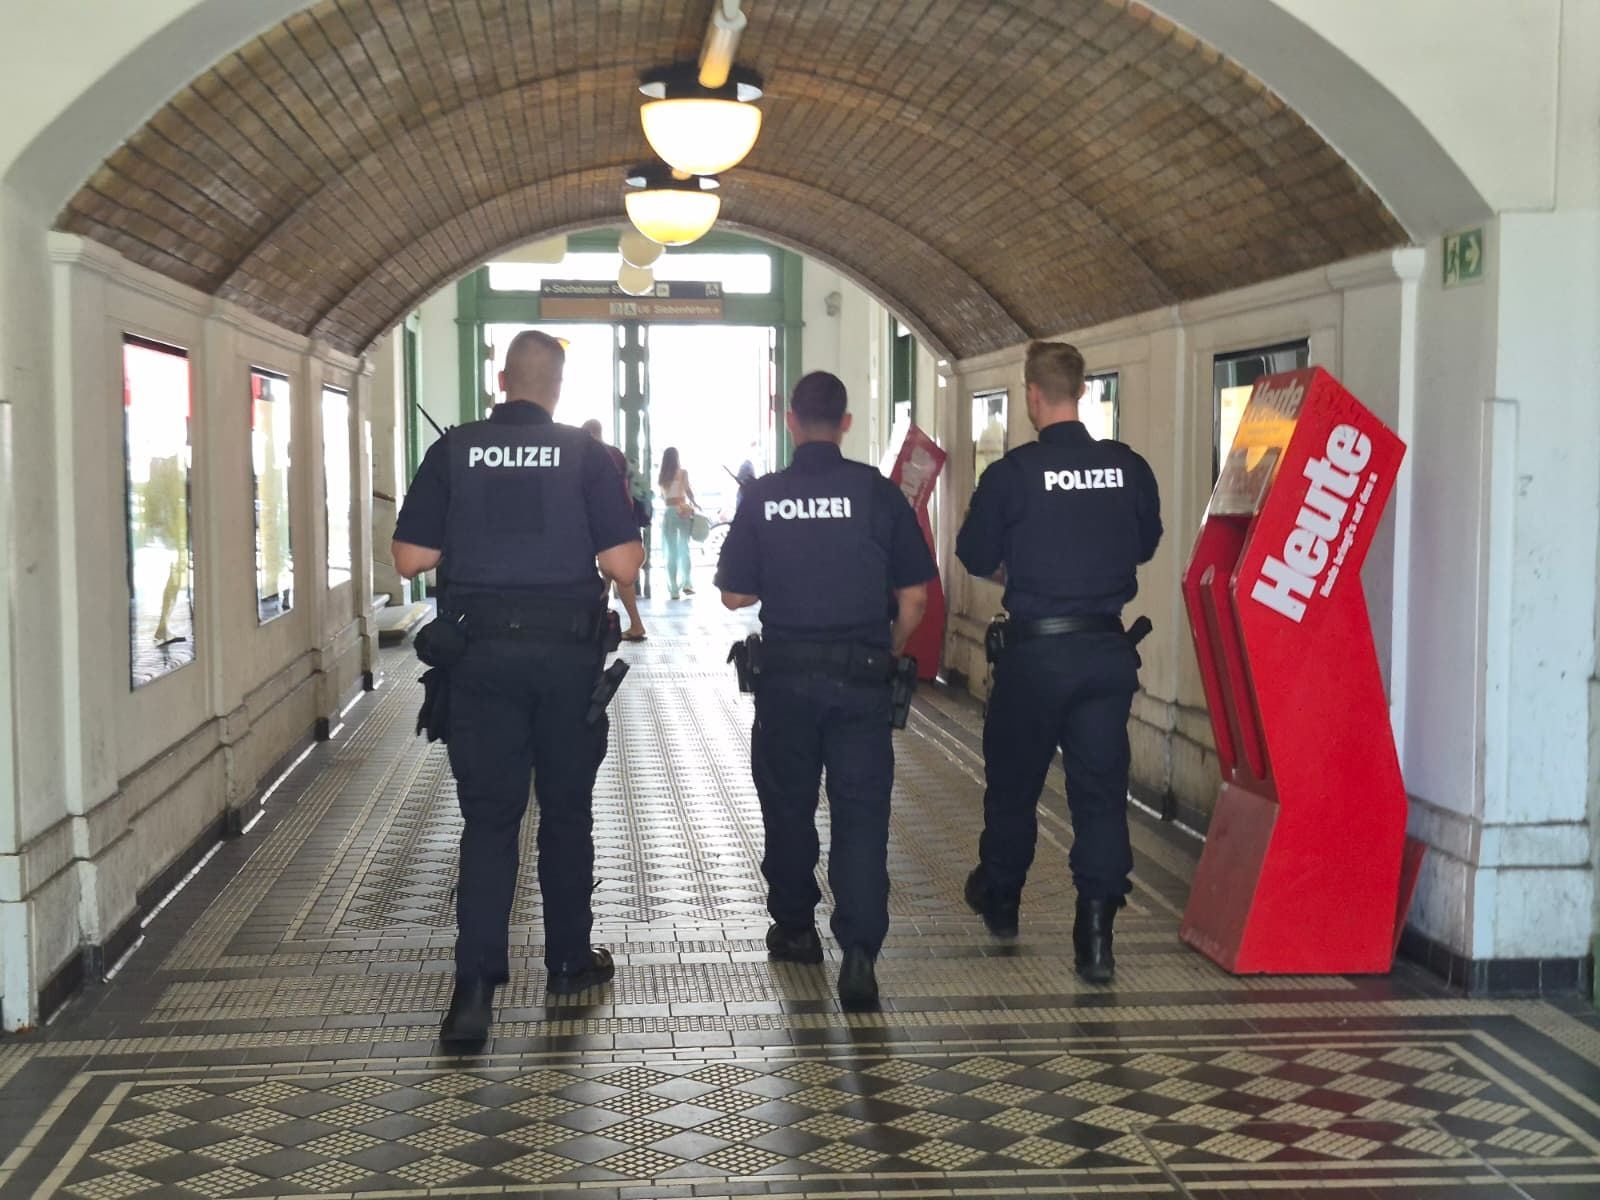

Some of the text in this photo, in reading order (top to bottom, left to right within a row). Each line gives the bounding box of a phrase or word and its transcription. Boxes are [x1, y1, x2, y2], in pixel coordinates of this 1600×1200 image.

[469, 446, 560, 467] POLIZEI
[1044, 468, 1123, 491] POLIZEI
[764, 497, 851, 520] POLIZEI
[1251, 423, 1373, 623] Heute
